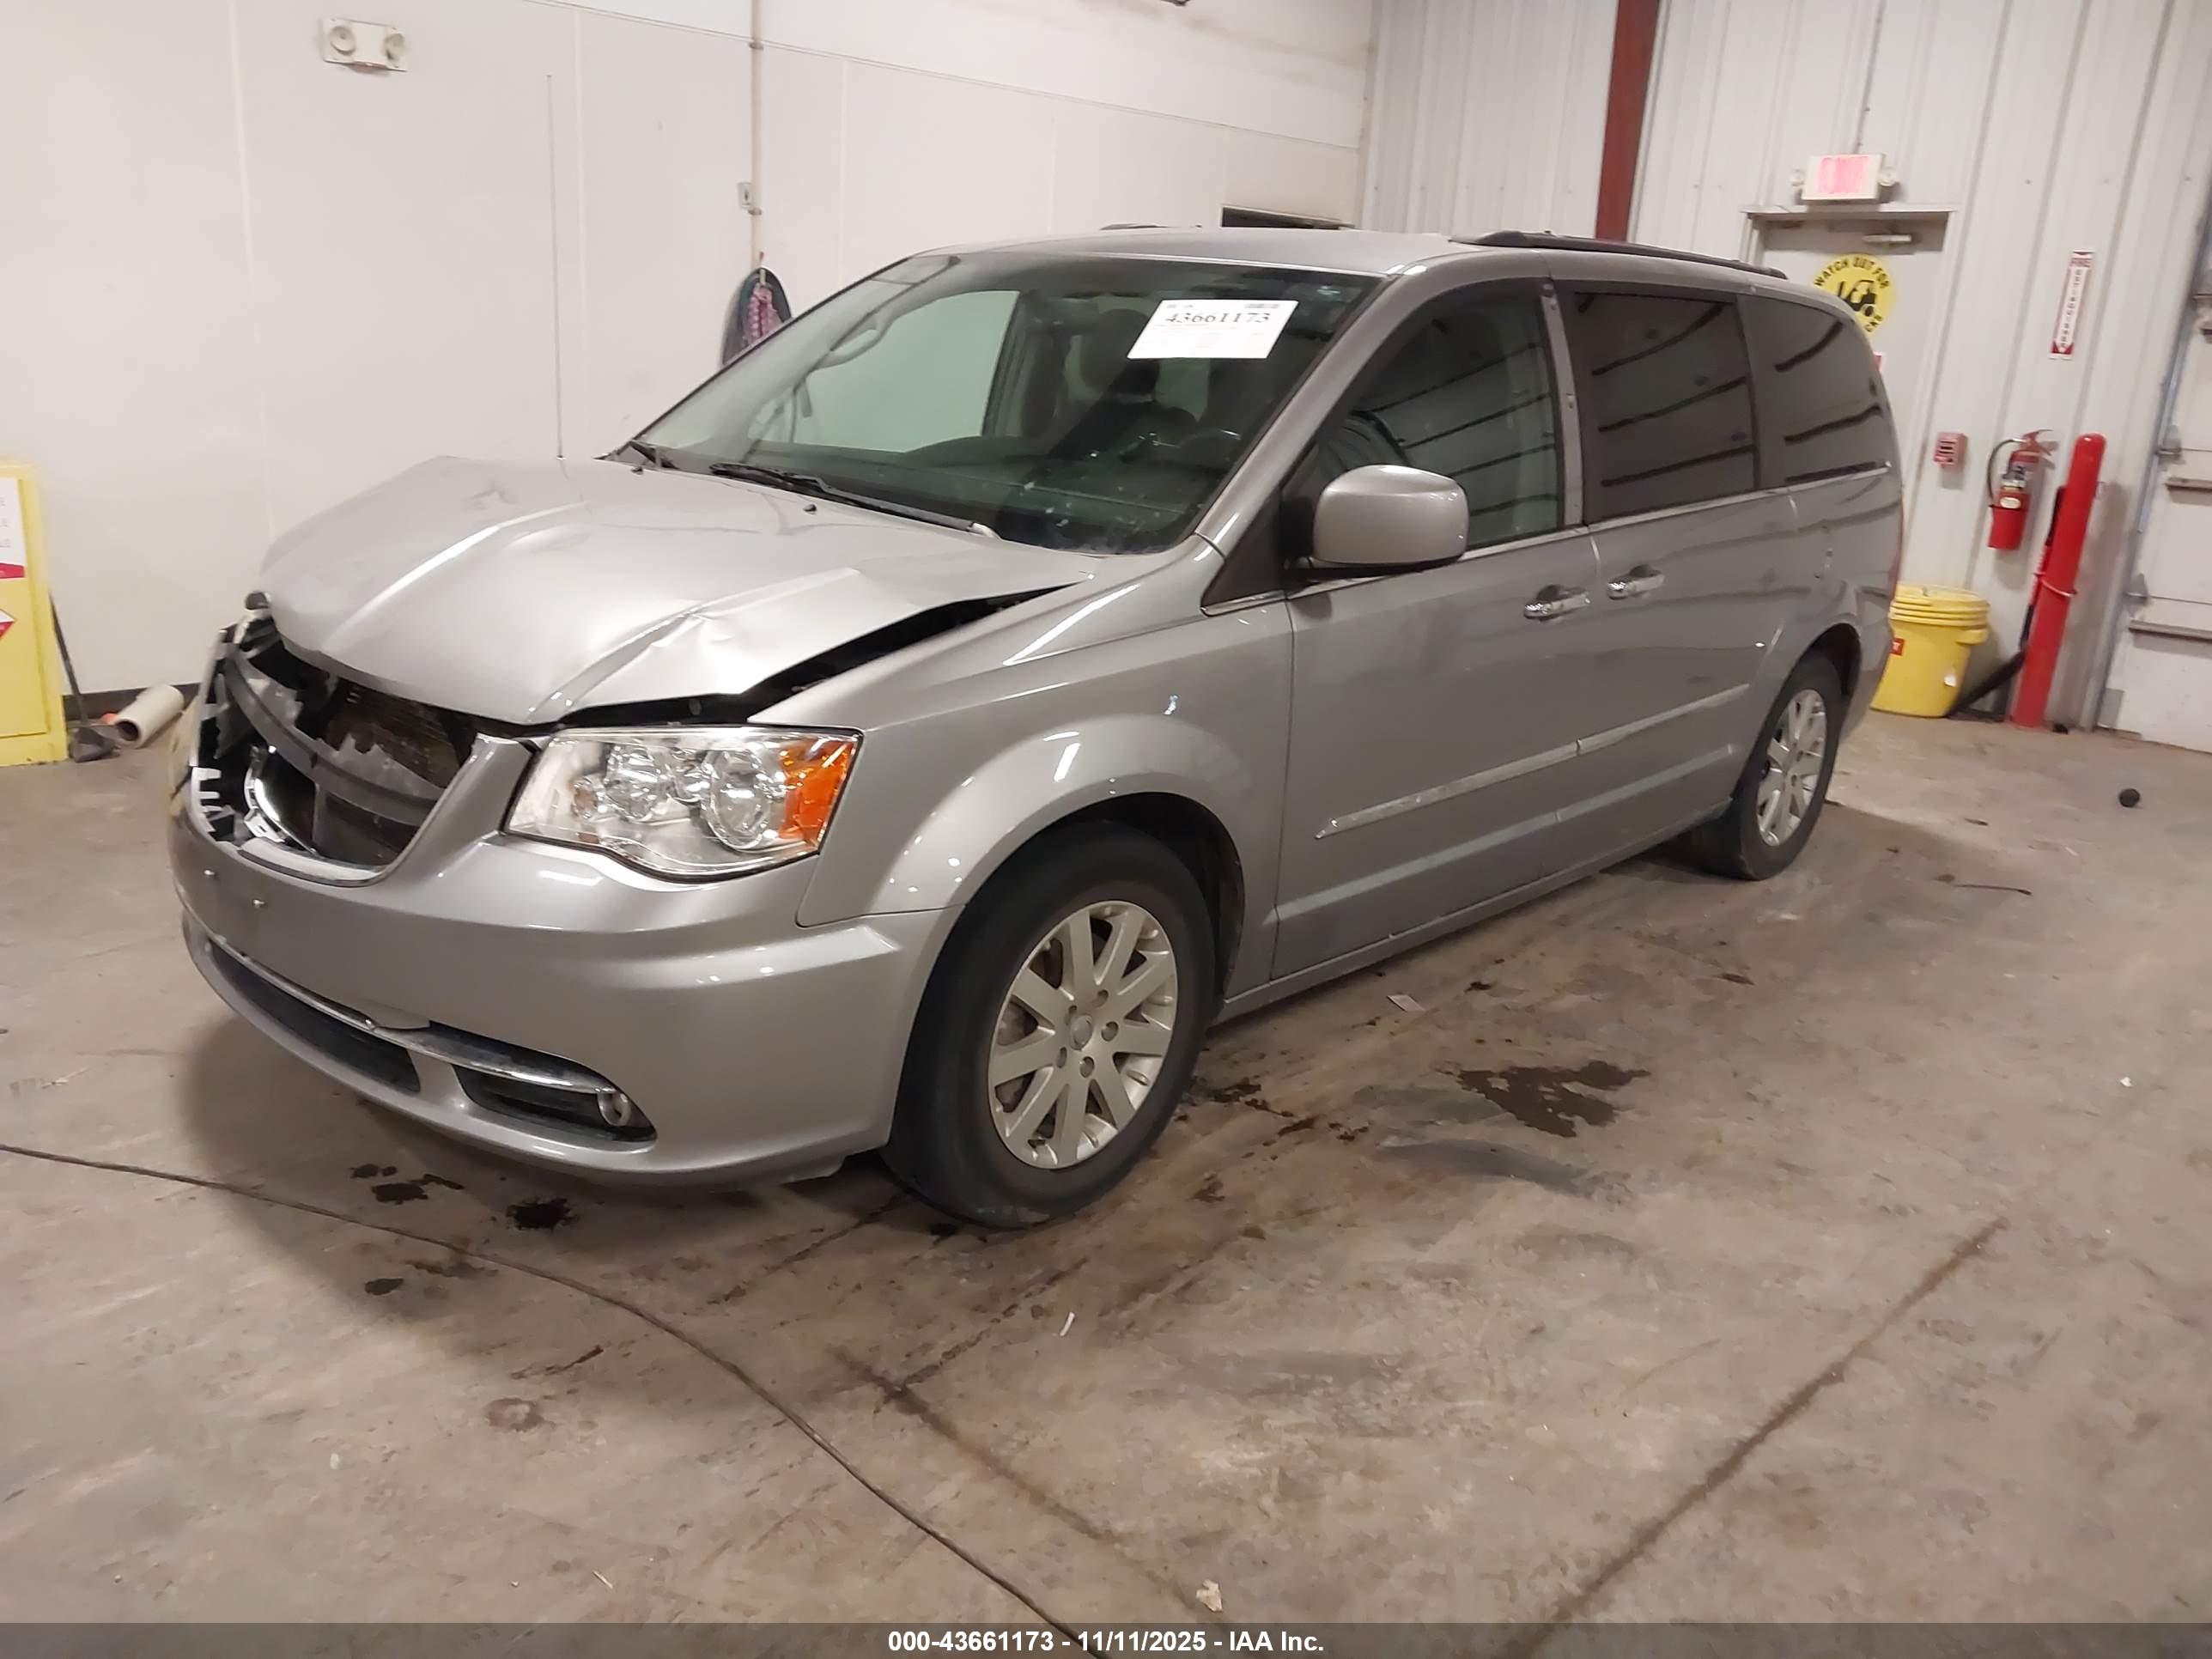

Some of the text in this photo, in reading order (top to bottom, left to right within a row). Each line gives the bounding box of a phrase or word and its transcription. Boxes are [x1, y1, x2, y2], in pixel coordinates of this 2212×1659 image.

[1814, 257, 1890, 289] WATCH OUT FOR
[1164, 312, 1271, 324] 43661173
